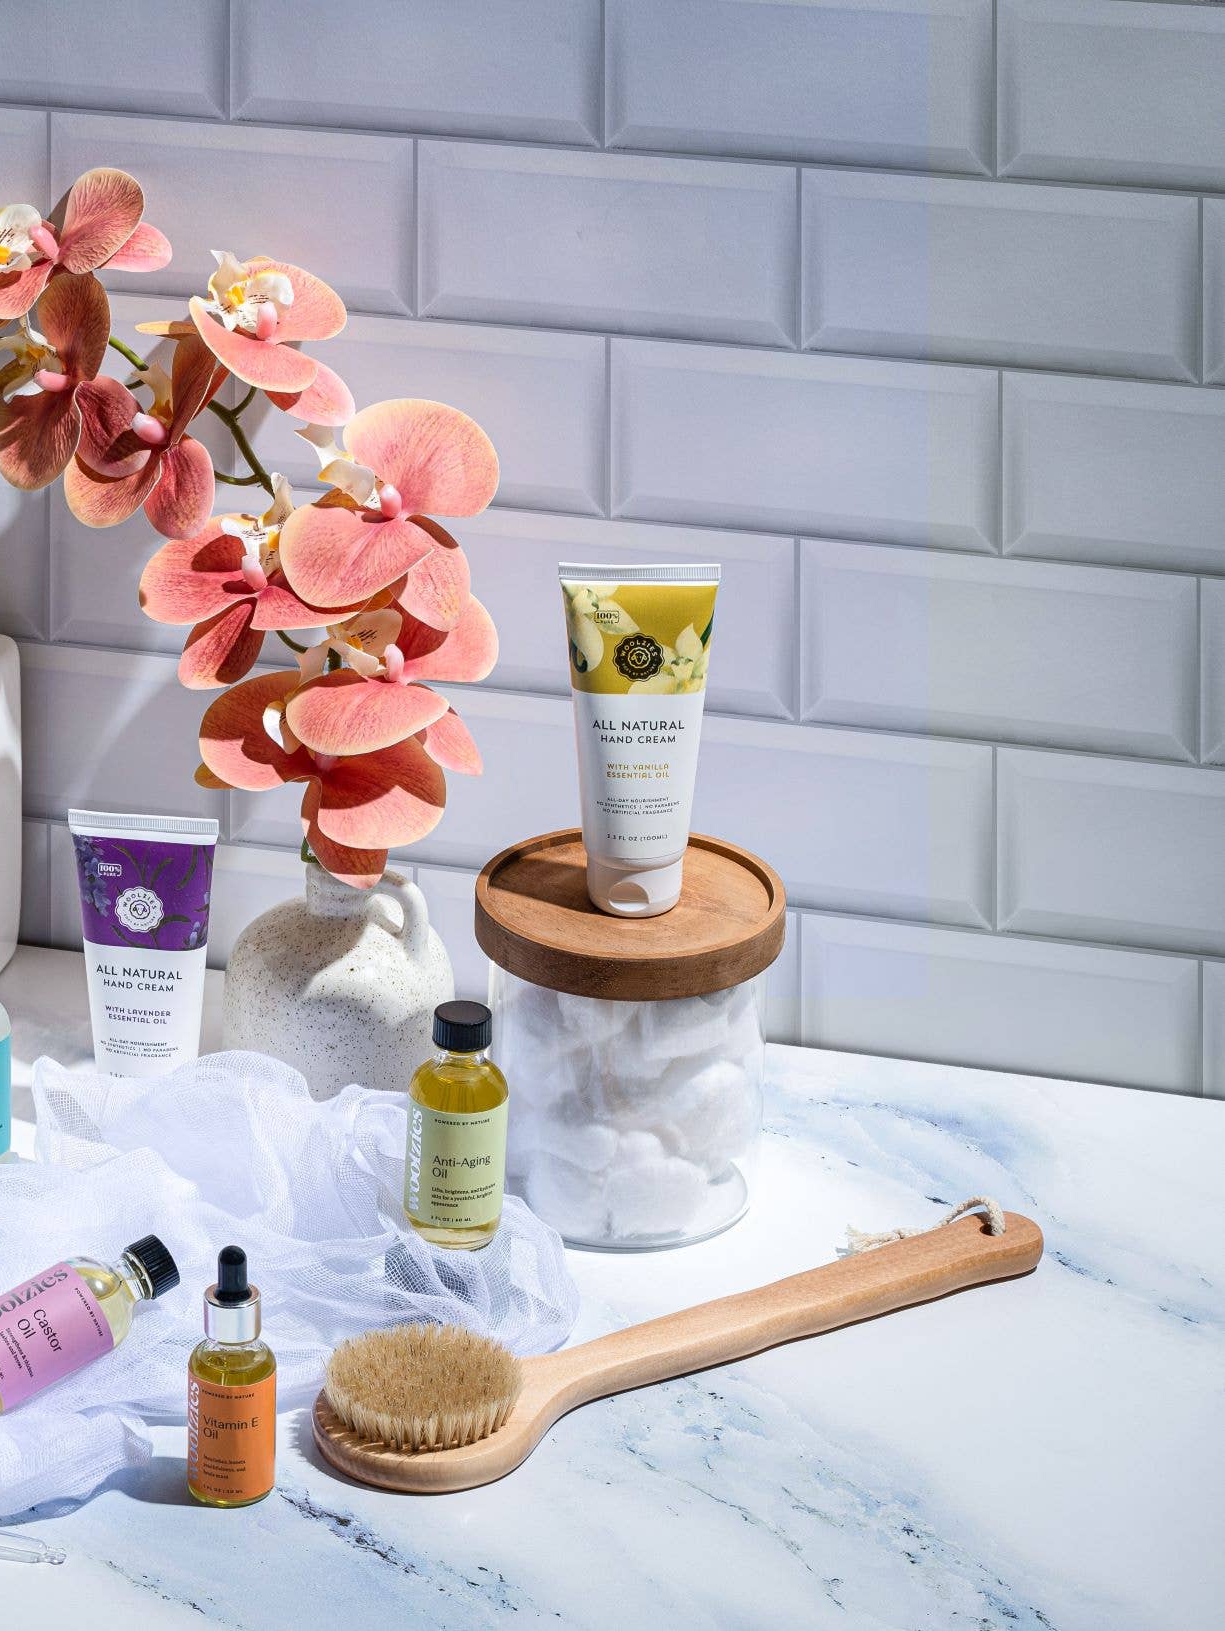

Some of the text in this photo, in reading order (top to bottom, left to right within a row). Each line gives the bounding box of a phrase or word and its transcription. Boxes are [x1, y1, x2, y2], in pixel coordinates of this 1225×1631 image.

[620, 640, 658, 658] WOOLZIES
[592, 720, 685, 731] ALL NATURAL
[600, 734, 676, 744] HAND CREAM
[606, 763, 669, 771] WITH VANILLA
[606, 771, 653, 779] ESSENTIAL
[99, 864, 121, 872] 100%
[122, 893, 157, 909] WOOLZIES
[96, 964, 183, 980] ALL NATURAL
[103, 979, 174, 992] HAND CREAM
[105, 1005, 171, 1017] WITH LAVENDER
[108, 1014, 151, 1024] ESSENTIAL
[408, 1108, 423, 1211] woolzies
[432, 1155, 491, 1169] Anti-Aging
[432, 1166, 448, 1179] Oil
[74, 1287, 91, 1311] POWERED
[17, 1318, 36, 1339] Oil
[33, 1308, 63, 1352] Castor
[203, 1415, 259, 1430] Vitamin E
[203, 1427, 219, 1440] Oil
